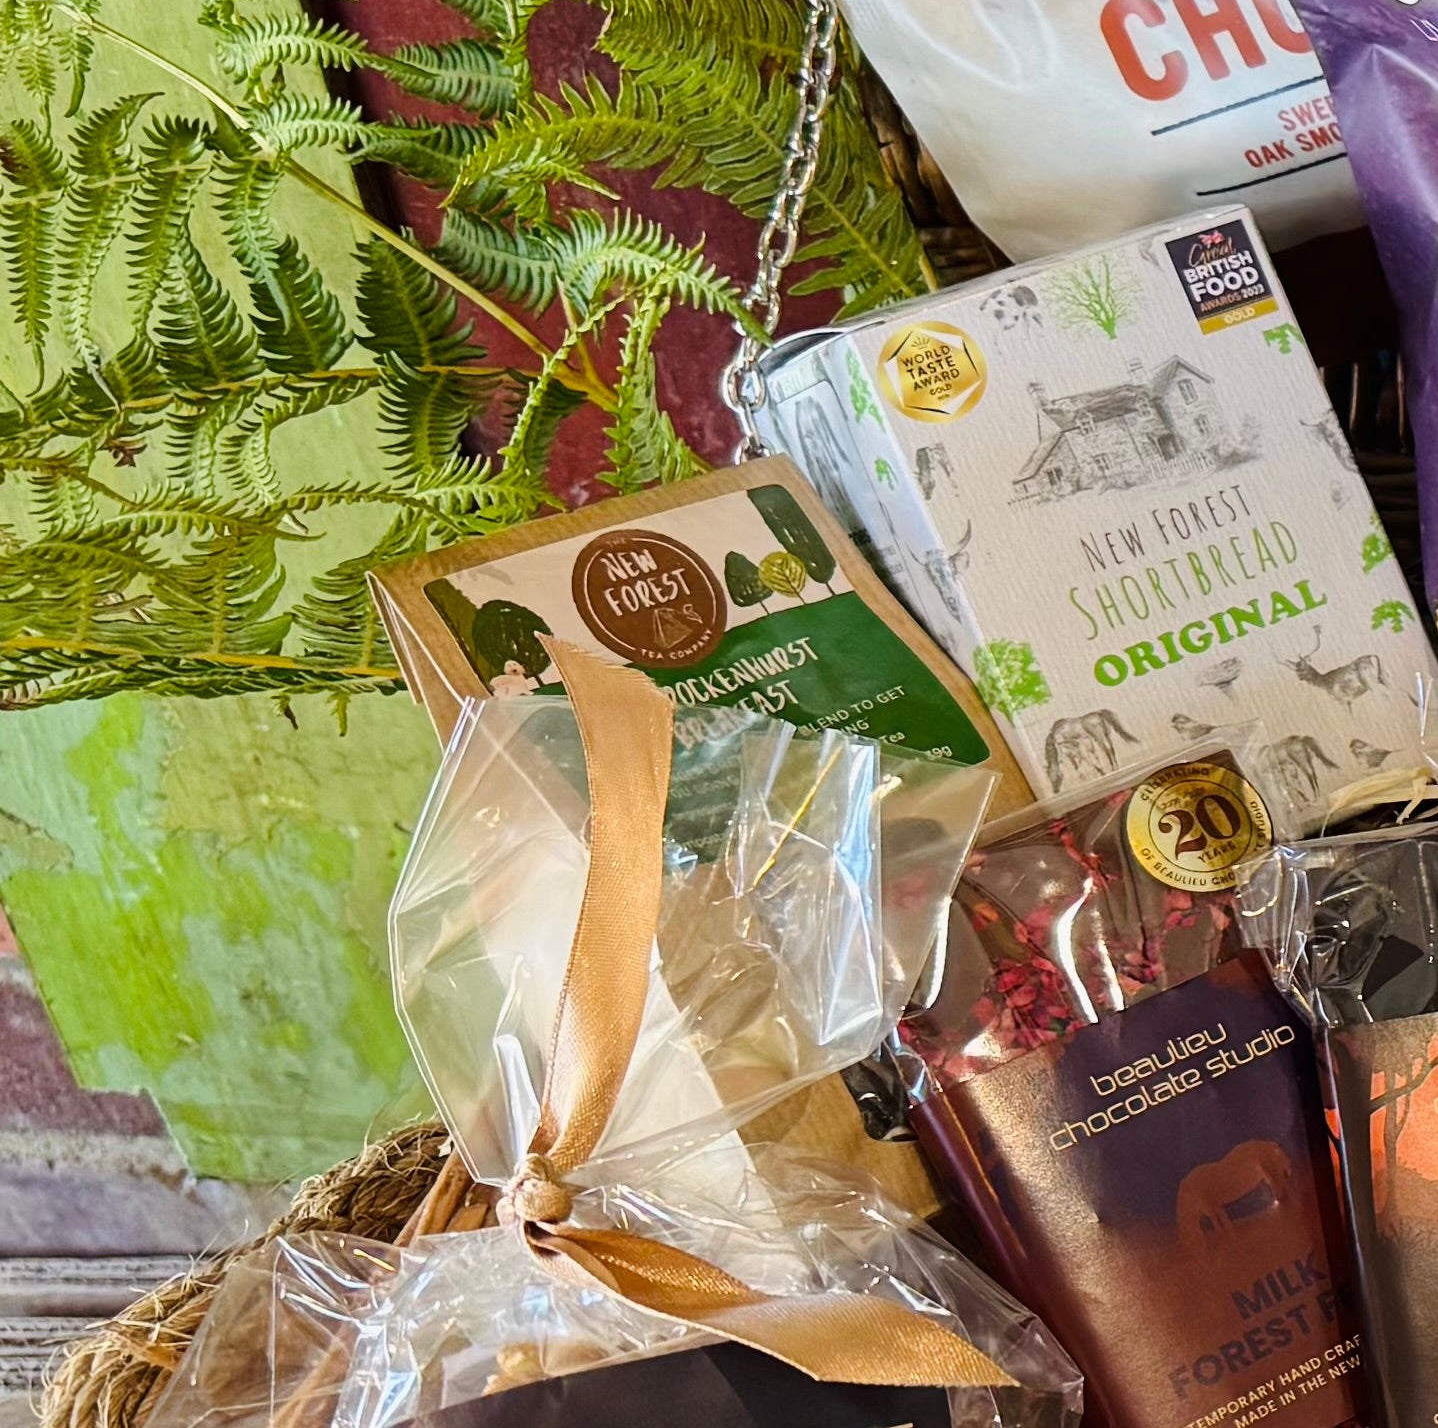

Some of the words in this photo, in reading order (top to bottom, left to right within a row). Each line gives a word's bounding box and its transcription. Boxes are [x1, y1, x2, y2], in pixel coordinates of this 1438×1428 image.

[1183, 250, 1253, 283] BRITISH
[1190, 267, 1259, 302] FOOD
[601, 547, 657, 580] NEW
[1080, 522, 1145, 572] NEW
[1152, 485, 1252, 539] FOREST
[603, 568, 693, 617] FOREST
[1068, 521, 1299, 641] SHORTBREAD
[1093, 579, 1327, 687] ORIGINAL
[1049, 1066, 1201, 1152] chocolate
[1204, 1022, 1296, 1080] studio
[1089, 1023, 1228, 1097] beaulieu
